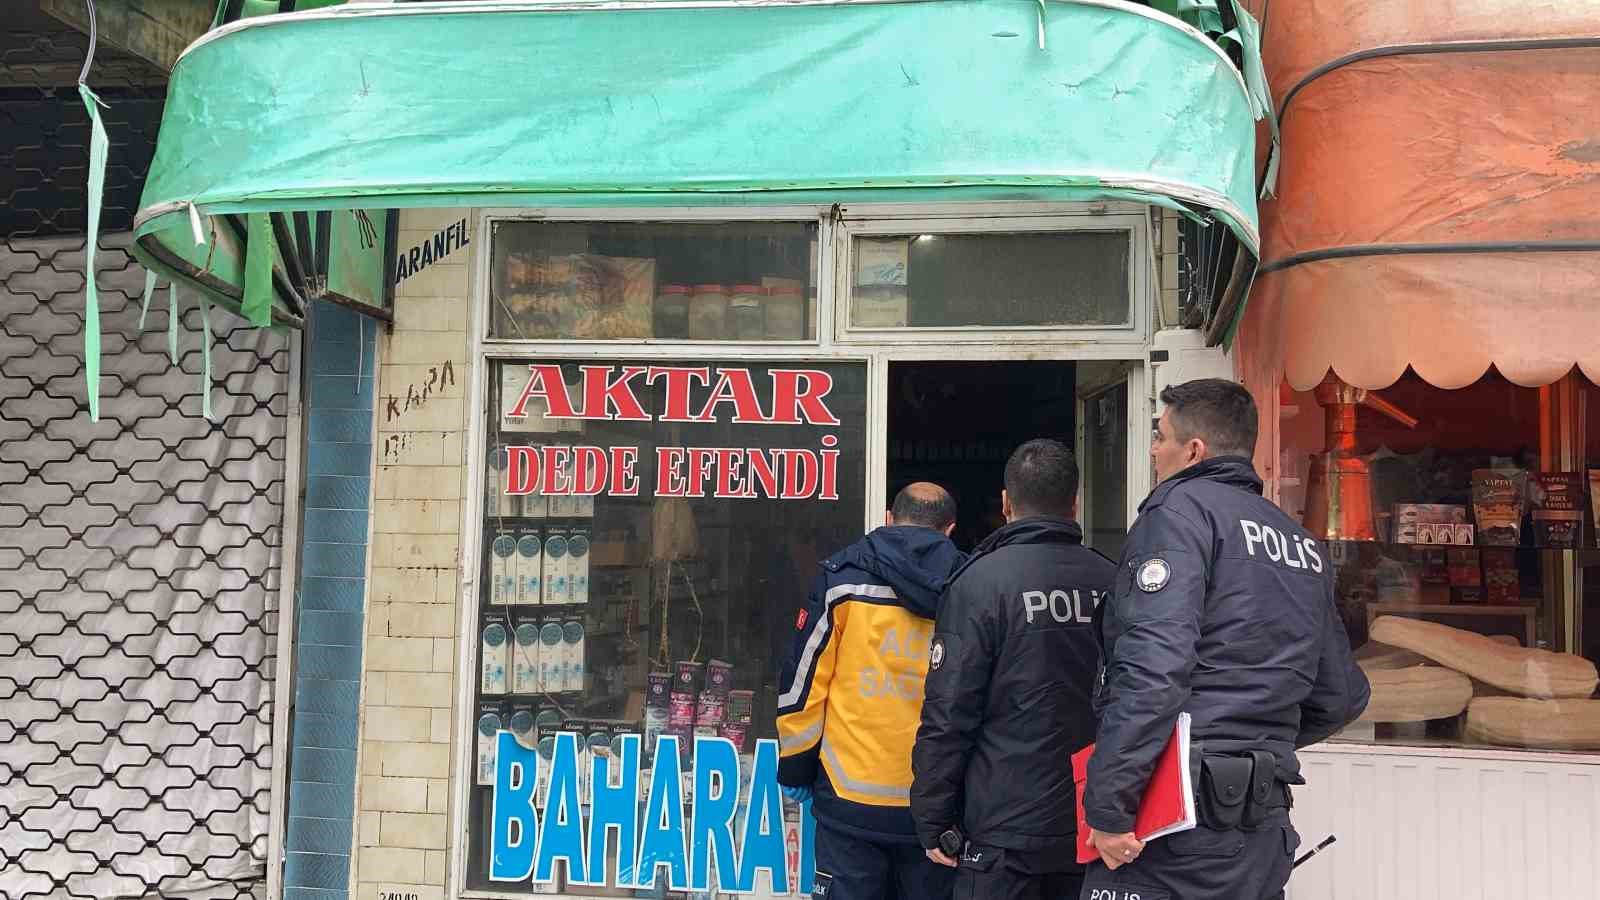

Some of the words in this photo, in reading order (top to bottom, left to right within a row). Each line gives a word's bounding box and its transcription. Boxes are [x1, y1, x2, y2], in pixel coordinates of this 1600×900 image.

[505, 364, 841, 426] AKTAR
[504, 445, 640, 497] DEDE
[655, 434, 839, 500] EFENDİ
[1022, 589, 1108, 624] POLİ
[880, 626, 931, 659] AC
